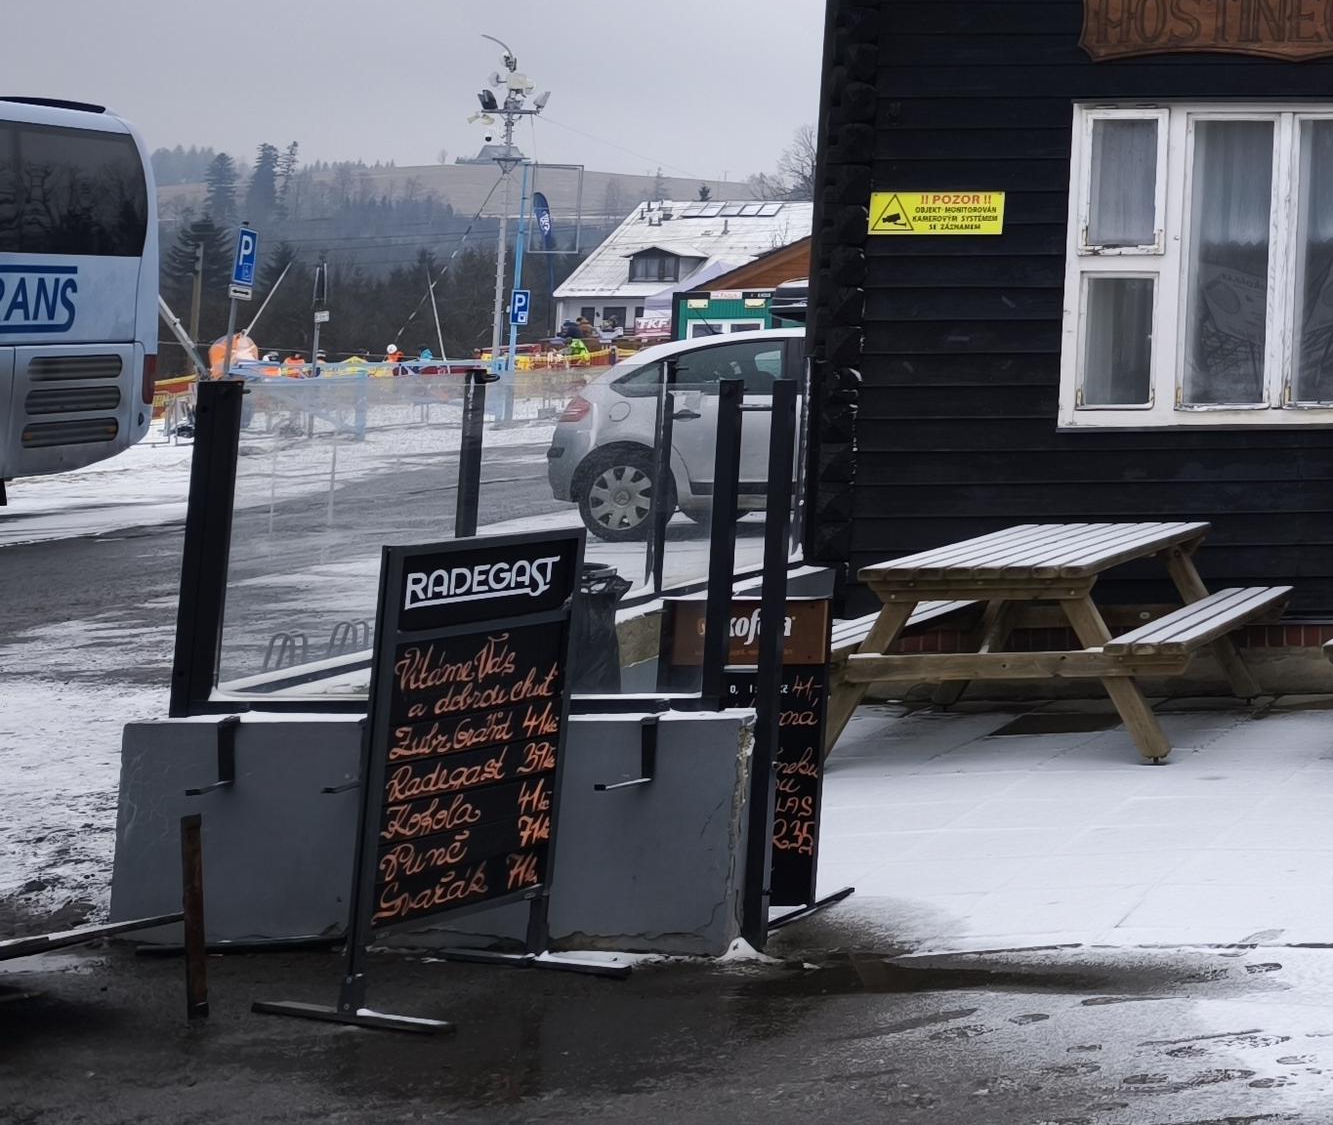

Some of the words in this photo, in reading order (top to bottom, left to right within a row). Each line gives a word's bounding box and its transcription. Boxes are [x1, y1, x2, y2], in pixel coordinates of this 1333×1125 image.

[932, 194, 981, 205] POZOR
[239, 235, 252, 266] P
[0, 277, 78, 332] ANS
[515, 294, 525, 313] P
[404, 555, 561, 610] RADEGAST
[408, 703, 428, 717] a
[389, 722, 452, 760] Zubr
[385, 746, 506, 803] Radegast
